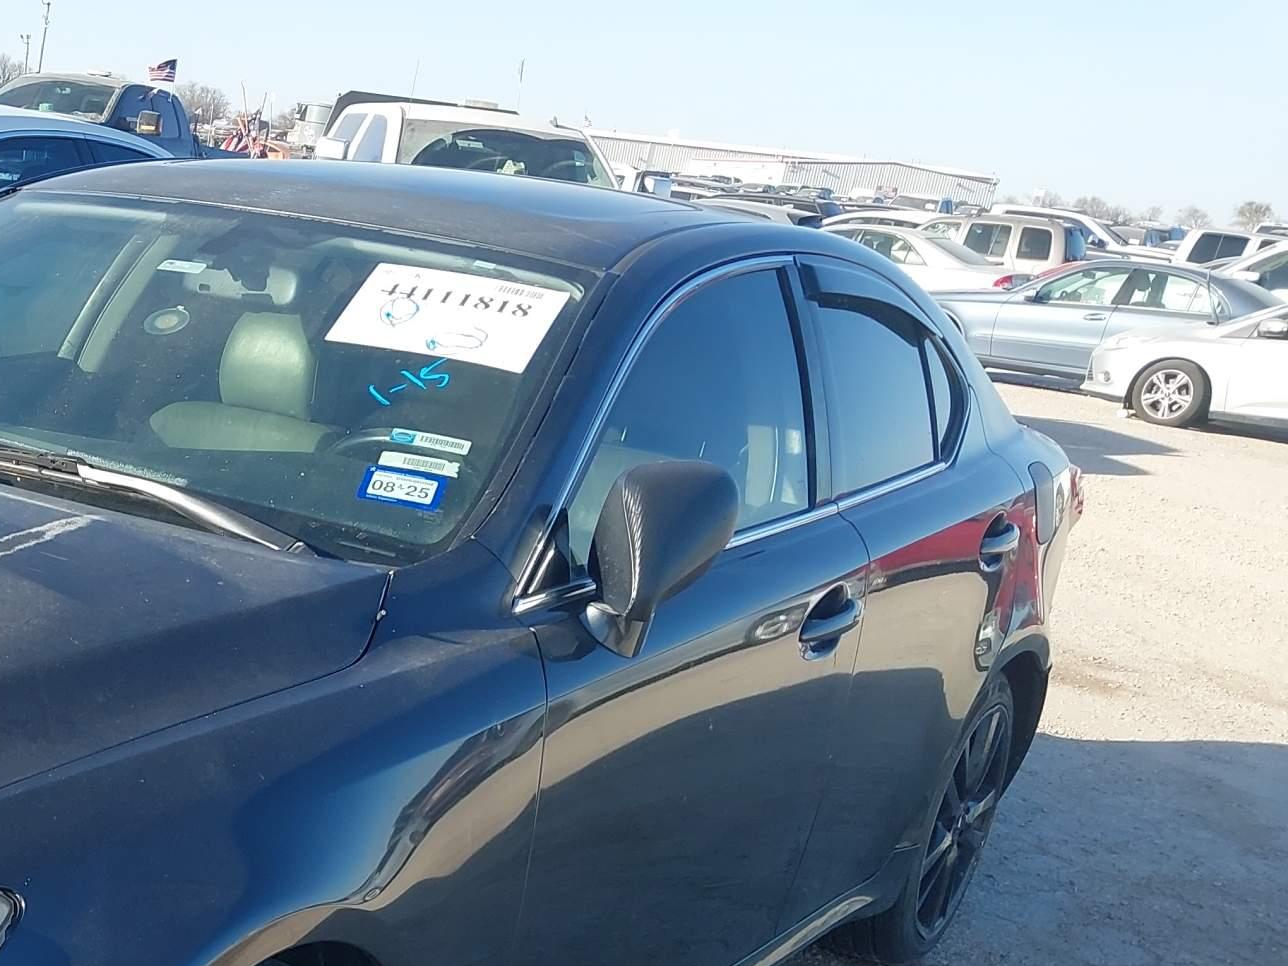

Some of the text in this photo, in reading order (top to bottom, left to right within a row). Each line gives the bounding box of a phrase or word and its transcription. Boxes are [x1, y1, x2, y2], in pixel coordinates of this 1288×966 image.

[380, 283, 534, 319] 44111818
[371, 479, 396, 494] 08
[405, 484, 431, 500] 25
